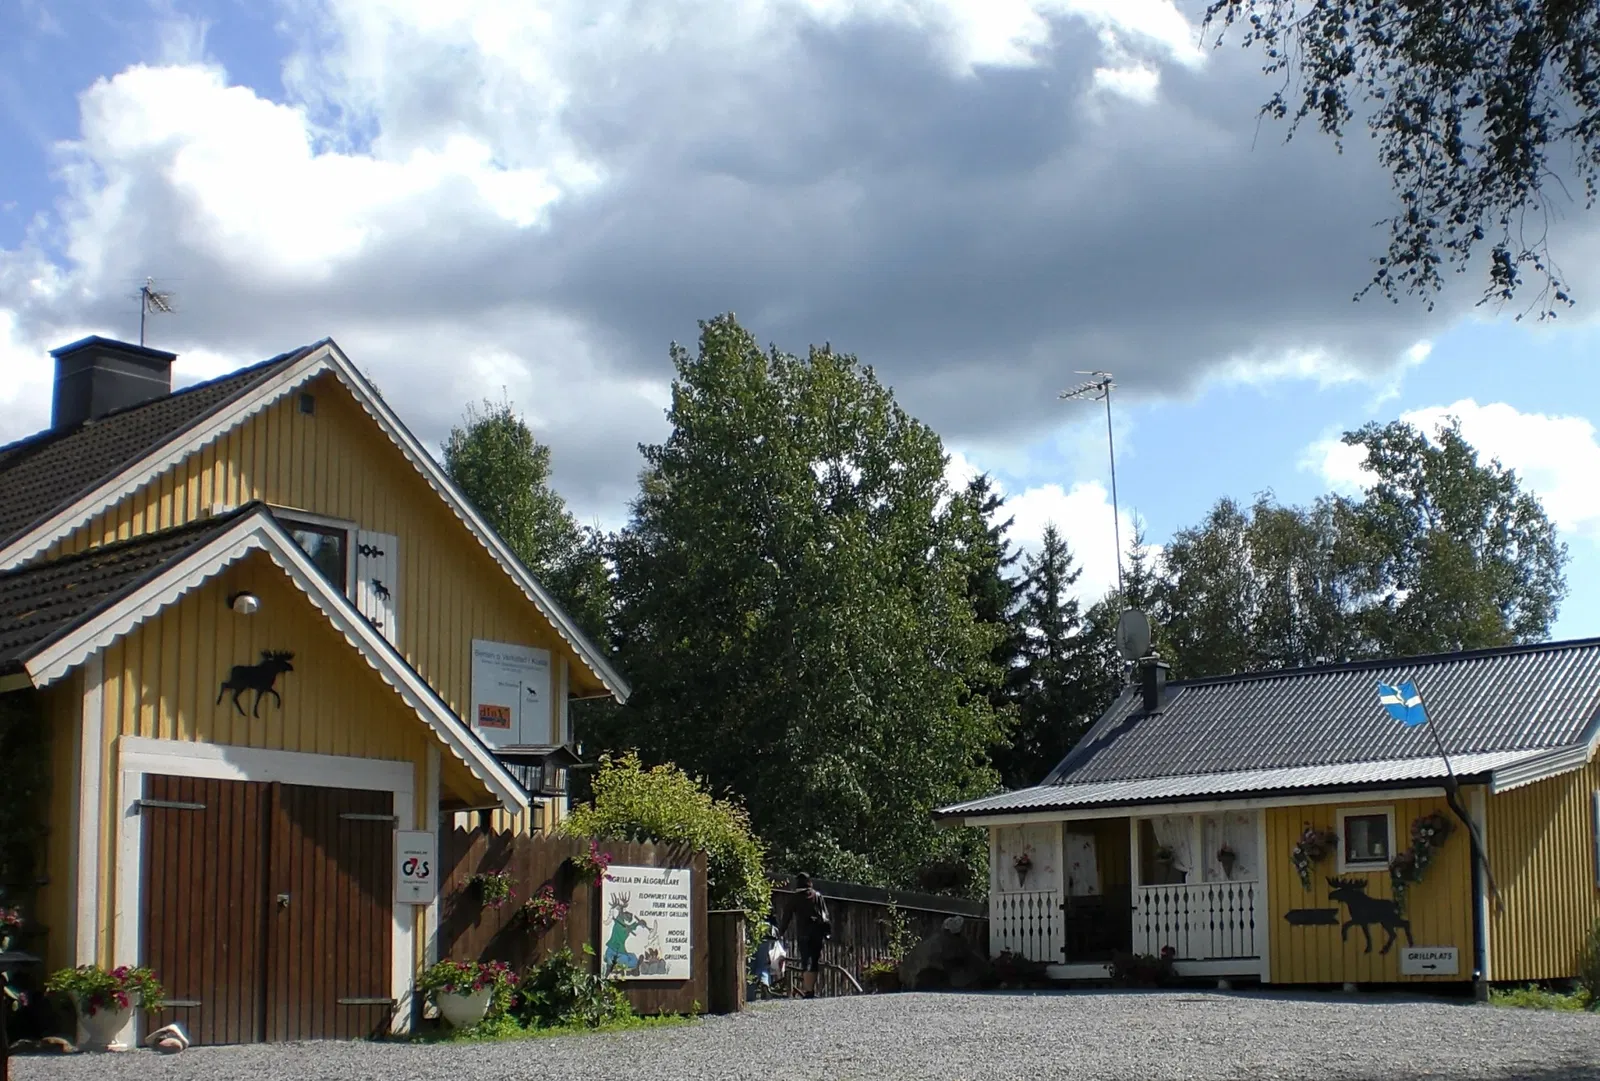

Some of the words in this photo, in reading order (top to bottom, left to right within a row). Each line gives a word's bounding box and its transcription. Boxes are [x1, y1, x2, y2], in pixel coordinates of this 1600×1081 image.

[402, 858, 429, 878] G4S
[634, 876, 641, 884] EN
[639, 892, 667, 900] ELCHWURST
[1408, 952, 1453, 960] GRILLPLATS
